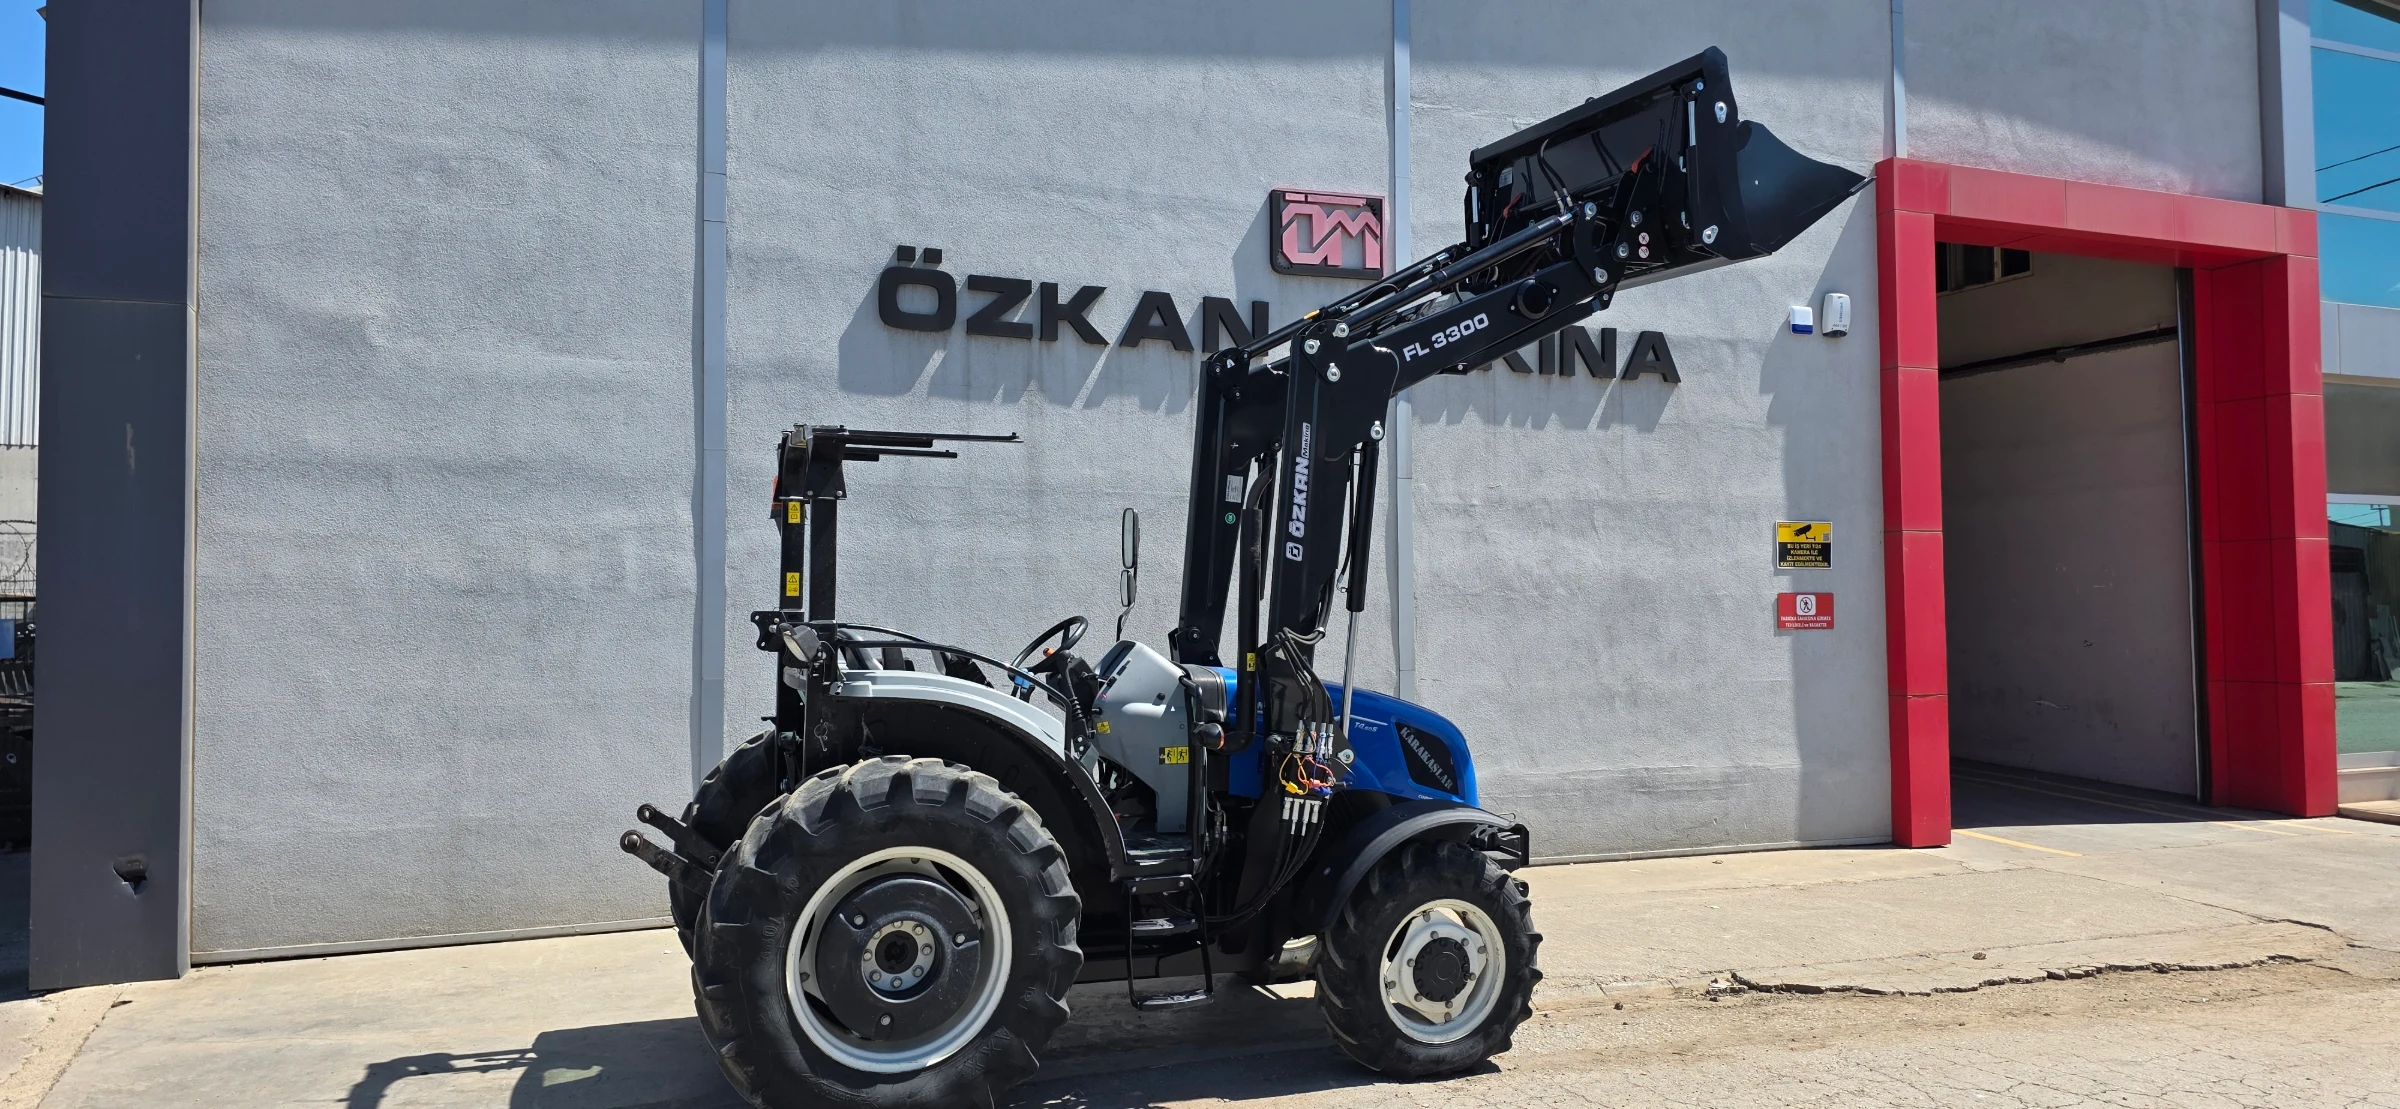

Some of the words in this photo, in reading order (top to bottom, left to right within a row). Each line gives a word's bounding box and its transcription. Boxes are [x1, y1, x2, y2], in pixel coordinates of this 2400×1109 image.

[878, 244, 1270, 357] ÖZKAN
[1403, 340, 1430, 362] FL
[1431, 312, 1489, 350] 3300
[1288, 456, 1309, 538] ÖZKAN
[1302, 425, 1310, 457] Makina
[1400, 727, 1454, 790] KARAKAŞLAR
